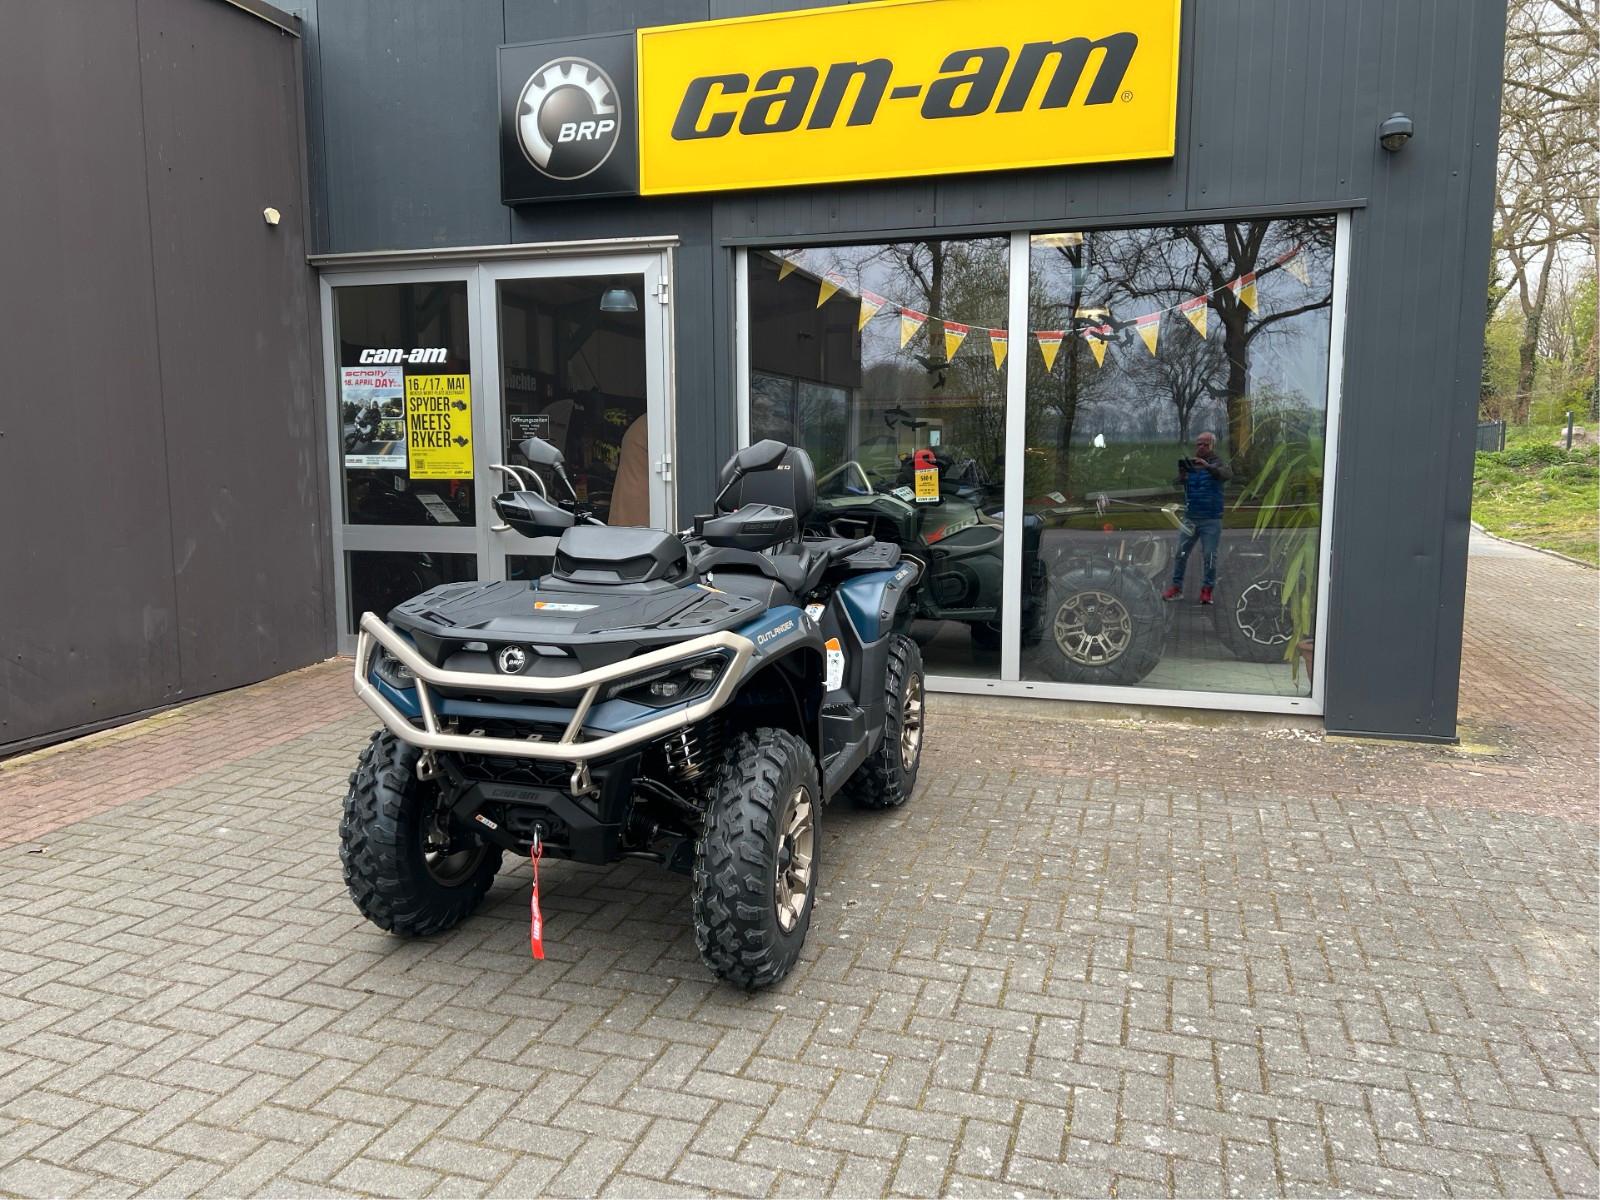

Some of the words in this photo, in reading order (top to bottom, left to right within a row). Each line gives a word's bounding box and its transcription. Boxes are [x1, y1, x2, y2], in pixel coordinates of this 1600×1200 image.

[671, 32, 1139, 142] can-am
[557, 118, 616, 143] BRP
[359, 347, 447, 364] can-am
[355, 378, 374, 386] APRIL
[375, 378, 394, 388] DAY
[447, 377, 465, 390] MAI
[409, 397, 450, 412] SPYDER
[411, 413, 451, 430] MEETS
[411, 431, 452, 448] RYKER
[757, 620, 794, 645] OUTLANDER
